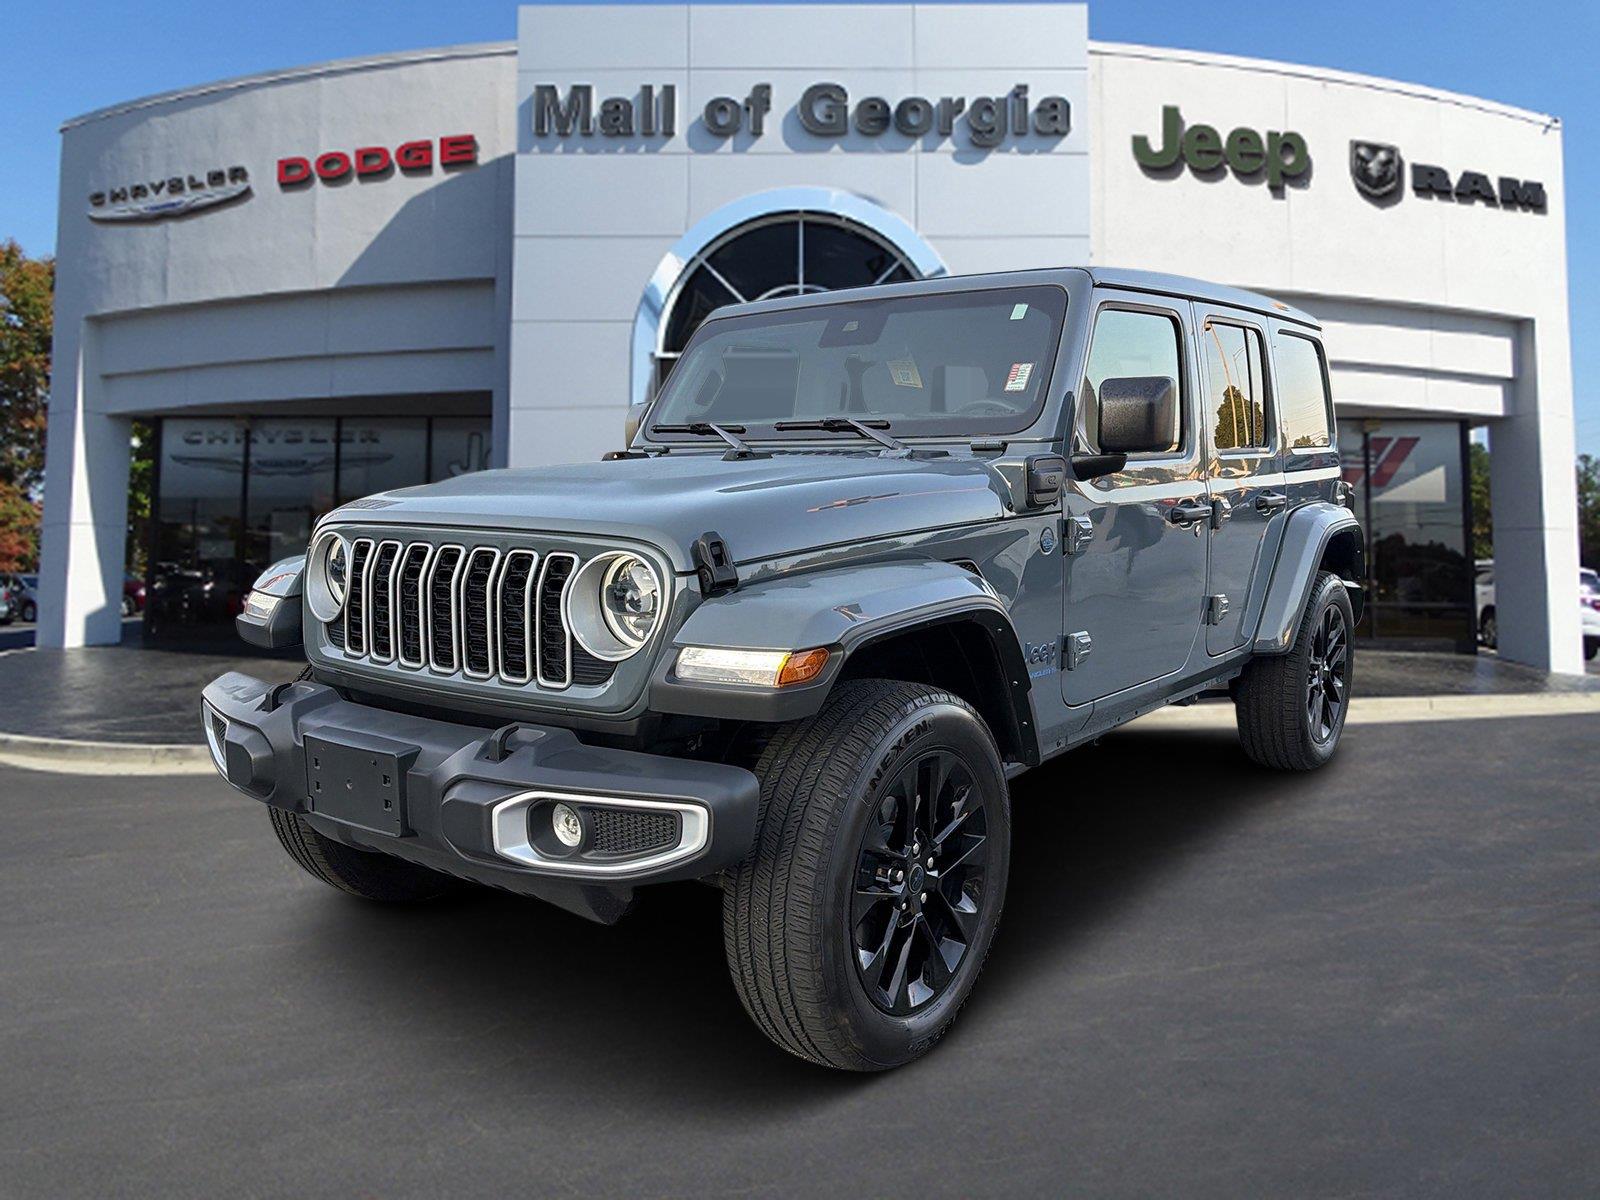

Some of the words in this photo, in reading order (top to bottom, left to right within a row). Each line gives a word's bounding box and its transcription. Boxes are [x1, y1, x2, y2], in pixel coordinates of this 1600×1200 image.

[533, 84, 676, 137] Mall
[704, 82, 772, 137] of
[800, 82, 1072, 148] Georgia
[277, 134, 478, 188] DODGE
[1131, 104, 1310, 194] Jeep
[89, 165, 249, 207] CHRYSLER
[1411, 162, 1548, 213] RAM
